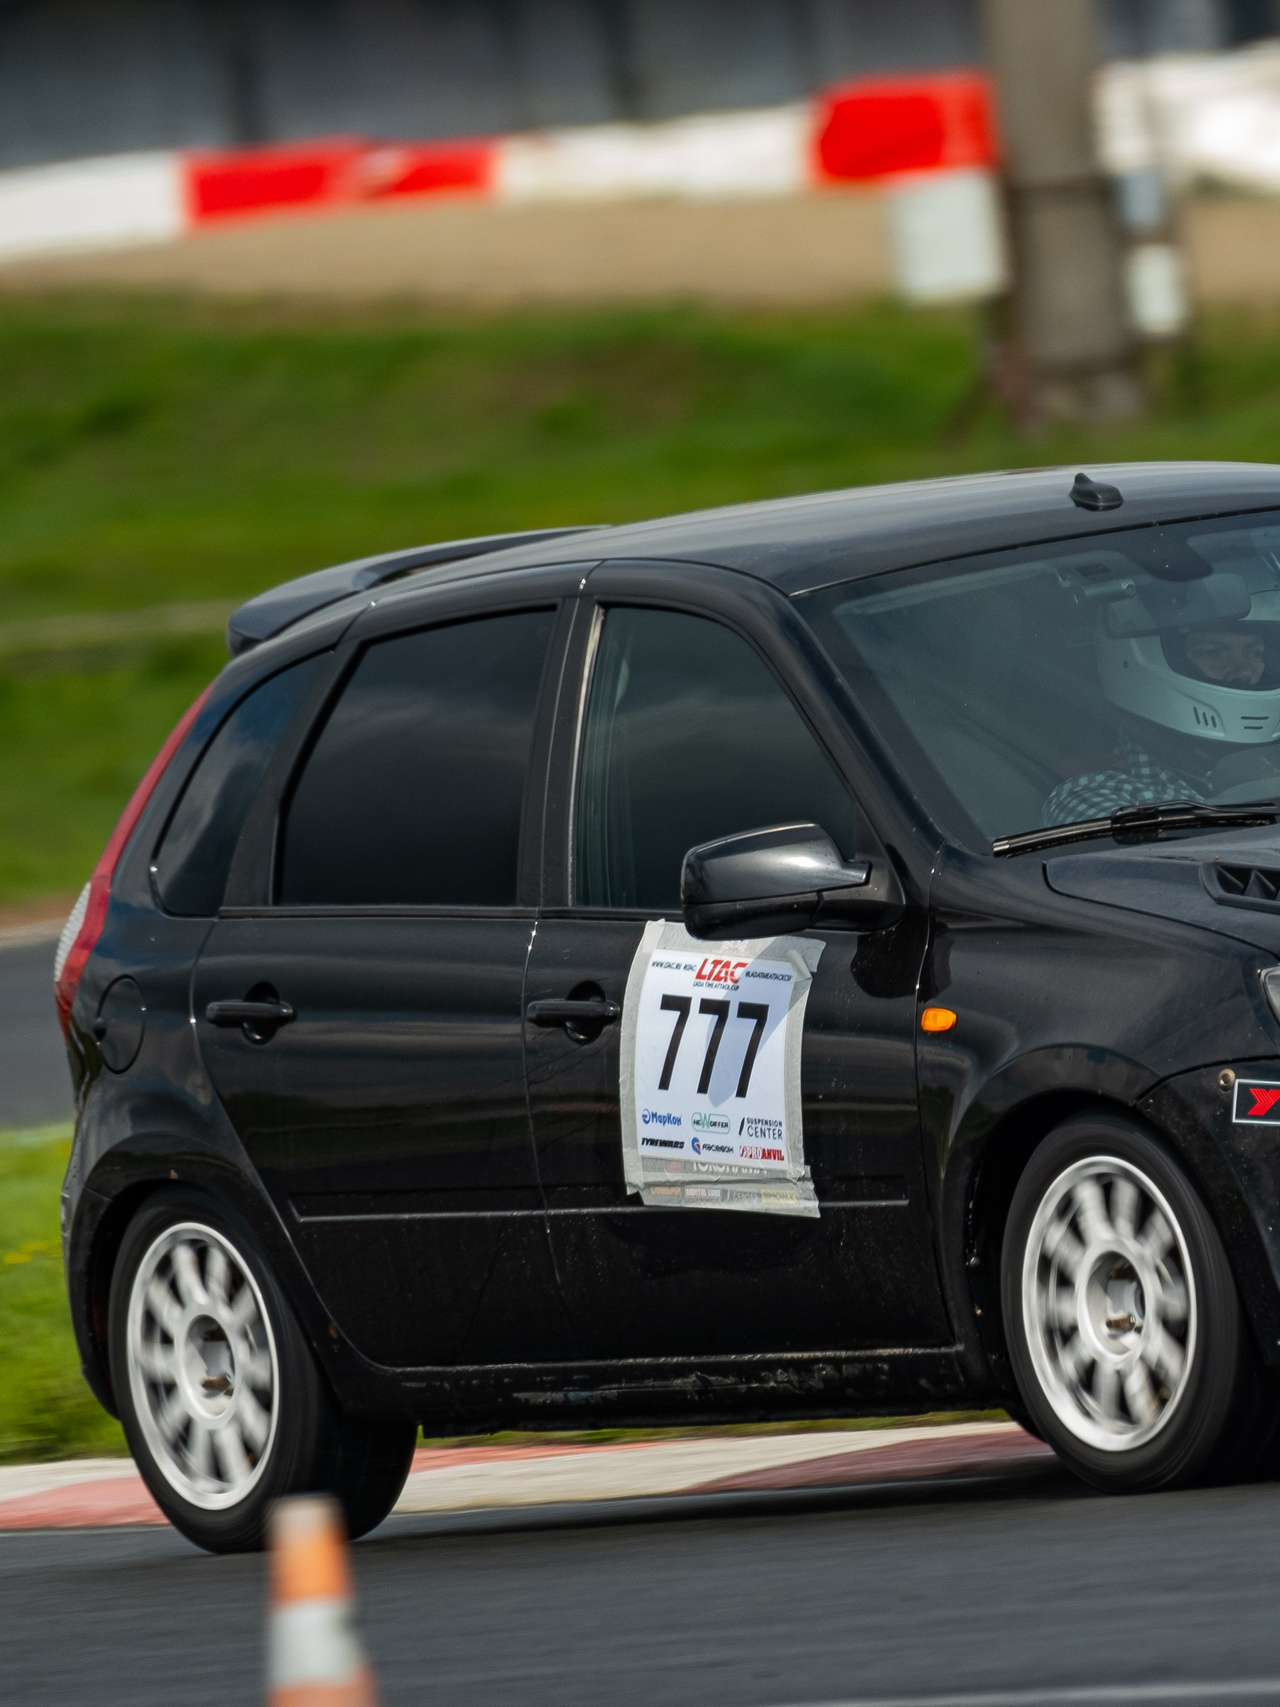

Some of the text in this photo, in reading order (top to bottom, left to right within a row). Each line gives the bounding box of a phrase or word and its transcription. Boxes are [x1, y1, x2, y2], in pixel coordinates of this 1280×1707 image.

[695, 958, 748, 984] LTAC
[658, 994, 769, 1098] 777
[747, 1117, 783, 1127] SUSPENSION
[747, 1125, 783, 1140] CENTER
